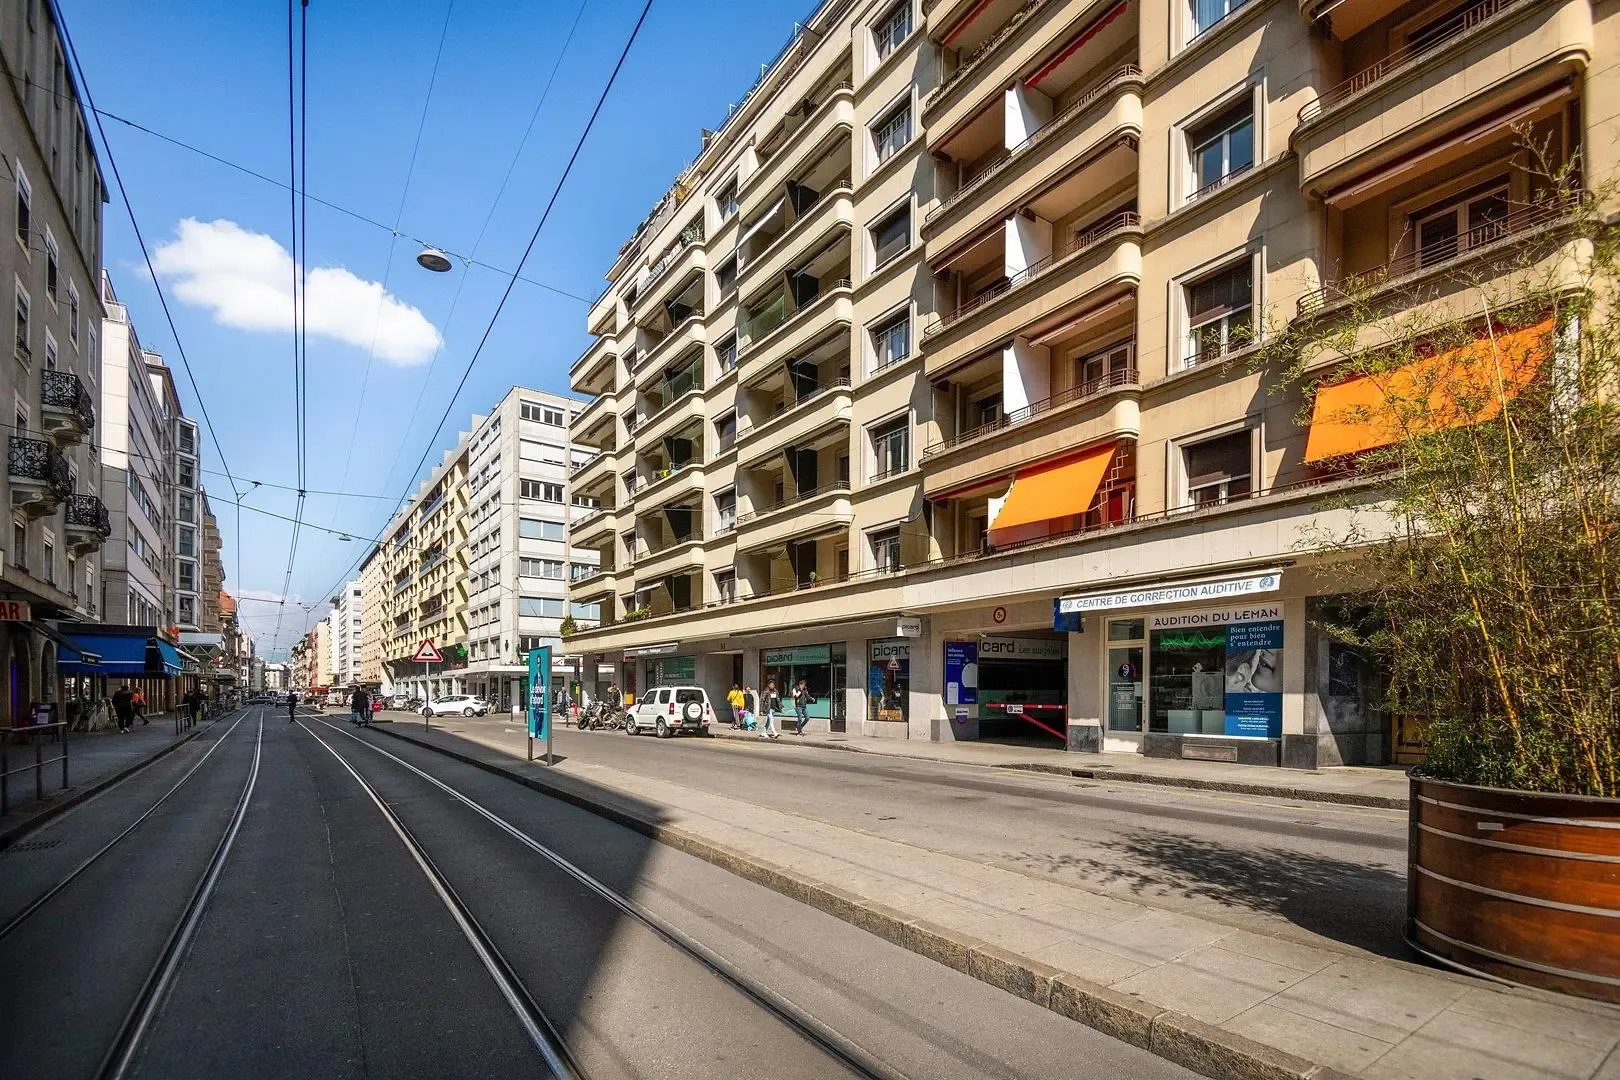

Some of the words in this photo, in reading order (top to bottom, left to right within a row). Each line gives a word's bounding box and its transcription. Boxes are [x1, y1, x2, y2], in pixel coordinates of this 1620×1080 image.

[1076, 597, 1113, 608] CENTRE
[1115, 595, 1127, 605] DE
[1130, 587, 1198, 603] CORRECTION
[1200, 580, 1254, 596] AUDITIVE
[0, 602, 20, 620] AR
[1154, 614, 1208, 627] AUDITION
[1212, 612, 1230, 622] DU
[1234, 607, 1279, 621] LEMAN
[1230, 626, 1246, 634] Bien
[1248, 623, 1280, 633] entendre
[1230, 634, 1247, 643] pour
[1249, 632, 1266, 640] bien
[979, 640, 1015, 653] icard
[766, 651, 793, 663] picard
